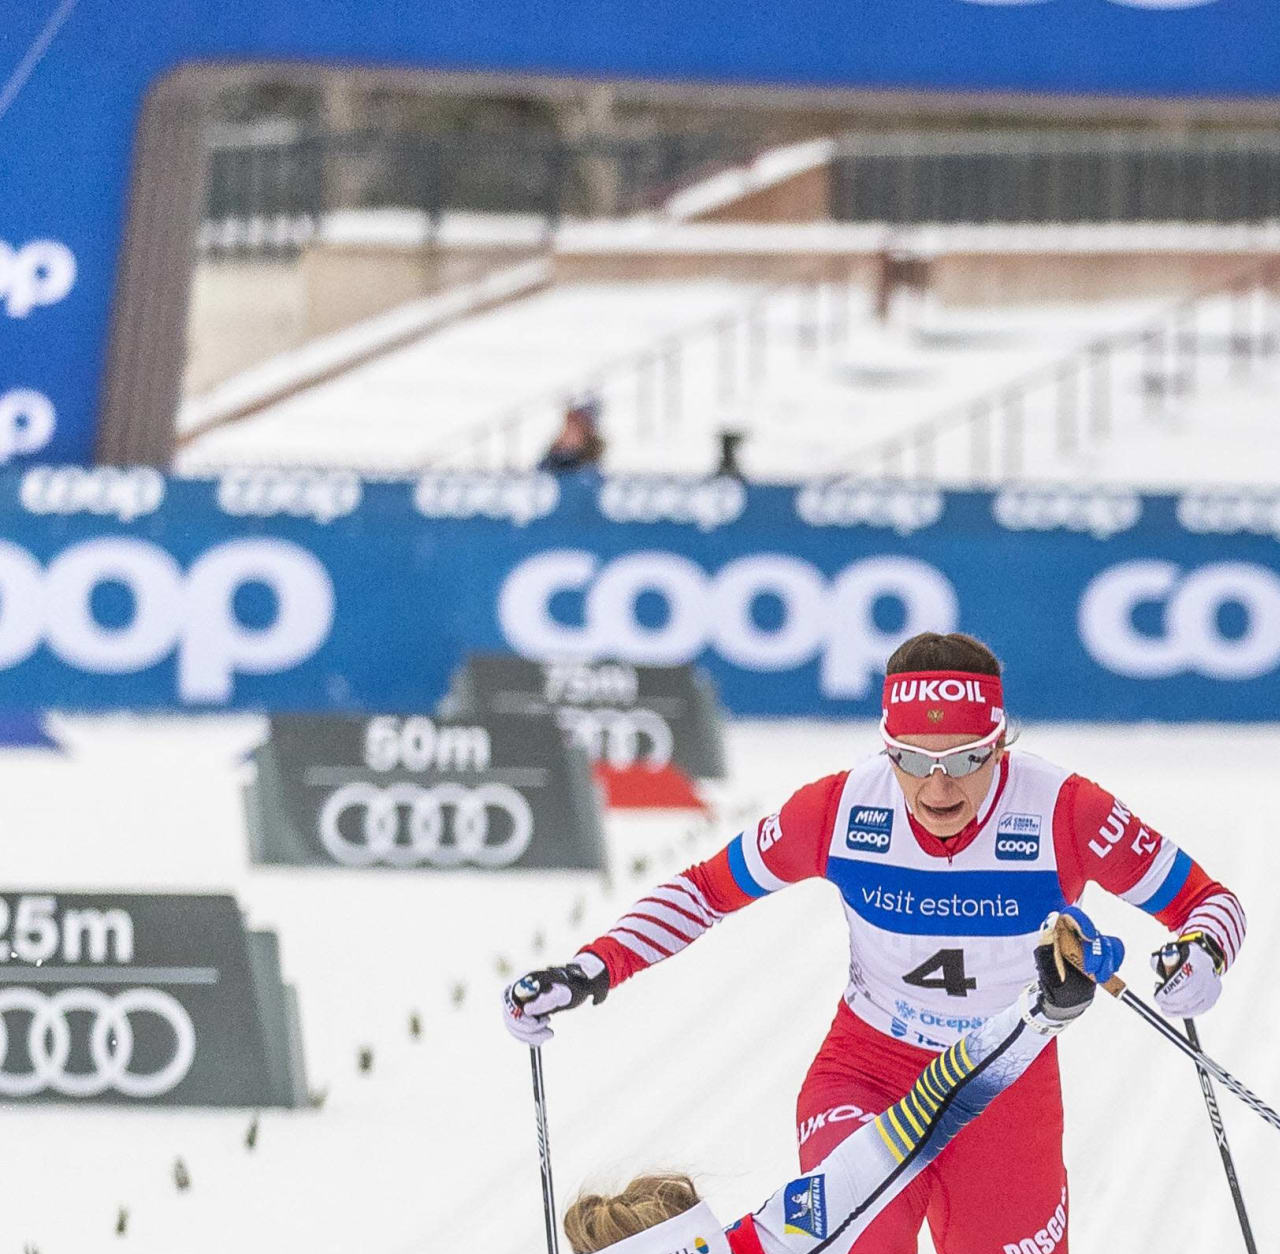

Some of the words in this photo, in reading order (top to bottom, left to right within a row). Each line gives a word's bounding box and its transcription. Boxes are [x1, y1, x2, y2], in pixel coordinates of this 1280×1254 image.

[498, 548, 958, 698] coop
[891, 680, 986, 704] LUKOIL
[848, 829, 889, 848] coop
[997, 839, 1038, 856] coop
[1088, 799, 1131, 859] LUK
[862, 885, 914, 914] visit
[920, 894, 1020, 918] estonia
[0, 895, 134, 965] 5m
[902, 948, 977, 997] 4
[919, 1011, 984, 1033] Otepä
[815, 1176, 824, 1236] MICHELIN
